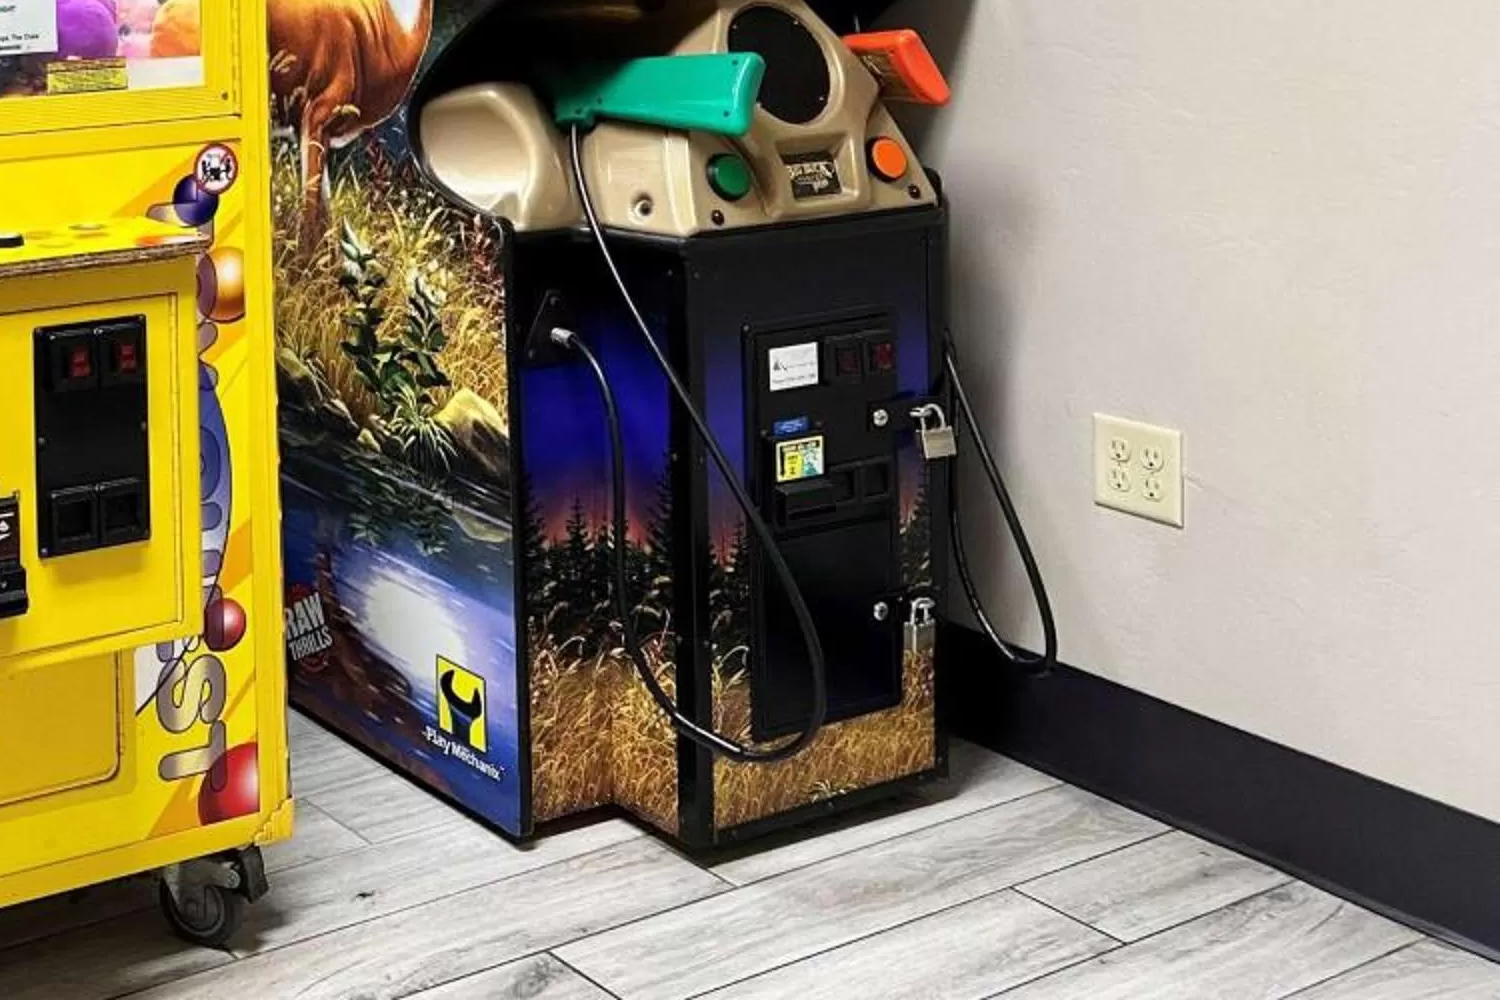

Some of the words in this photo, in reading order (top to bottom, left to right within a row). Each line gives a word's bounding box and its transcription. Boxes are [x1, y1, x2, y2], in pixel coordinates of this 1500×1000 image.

[284, 592, 325, 641] RAW
[288, 625, 333, 661] THRILLS
[422, 724, 452, 757] Play
